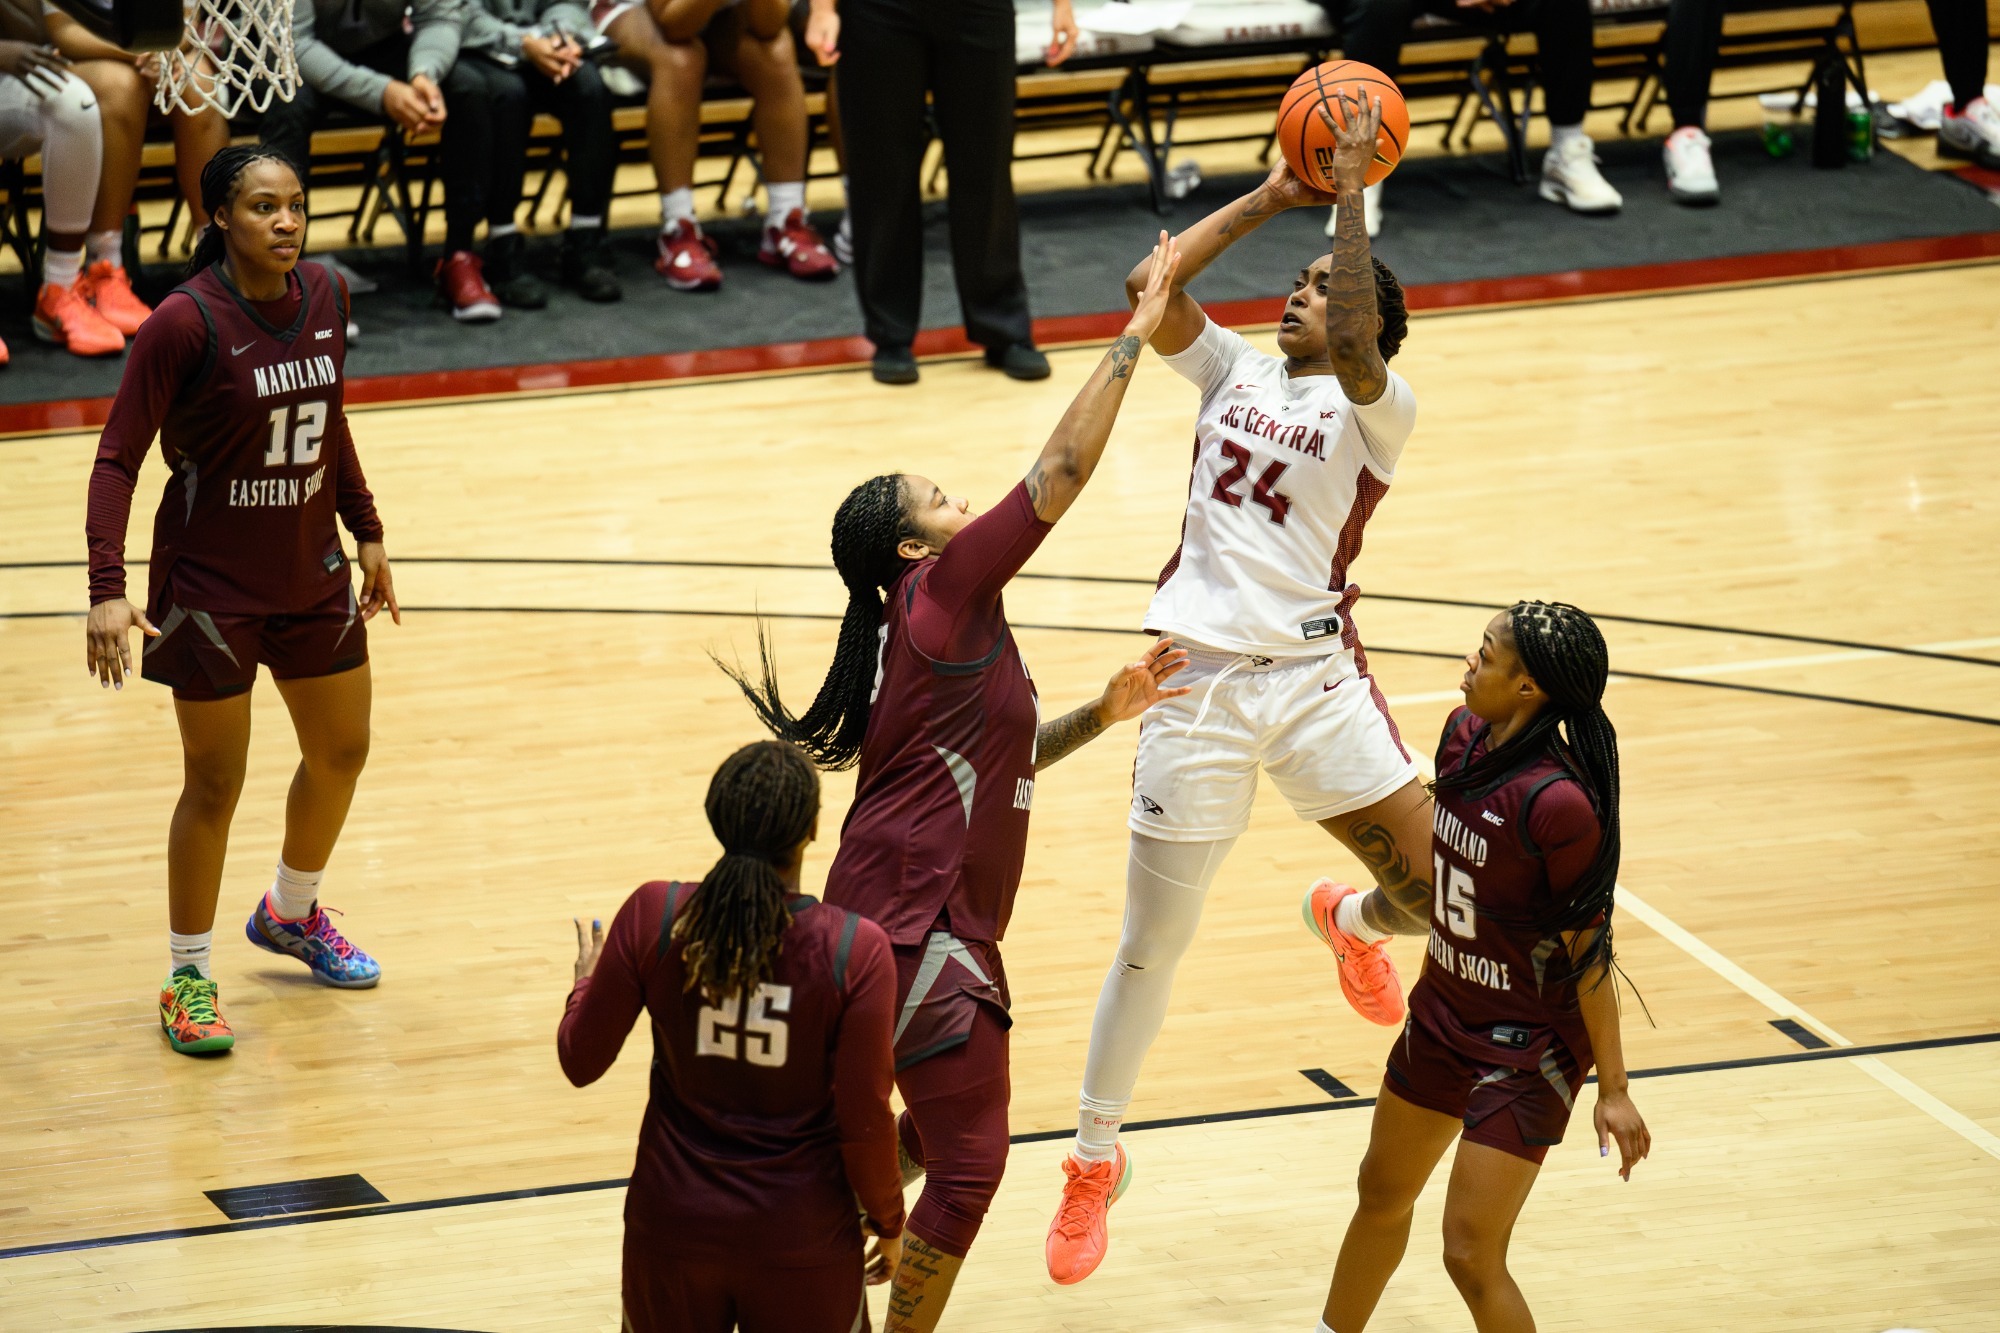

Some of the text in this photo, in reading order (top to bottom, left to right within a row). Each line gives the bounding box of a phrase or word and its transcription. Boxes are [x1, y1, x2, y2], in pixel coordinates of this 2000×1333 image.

[315, 329, 333, 340] MEAC
[254, 354, 336, 398] MARYLAND
[264, 400, 328, 467] 12
[1244, 406, 1326, 462] CENTRAL
[229, 478, 300, 507] EASTERN
[1208, 437, 1292, 528] 24
[1481, 809, 1505, 827] MEAC
[1434, 849, 1478, 940] 15
[1459, 952, 1511, 991] SHORE
[696, 982, 792, 1068] 25
